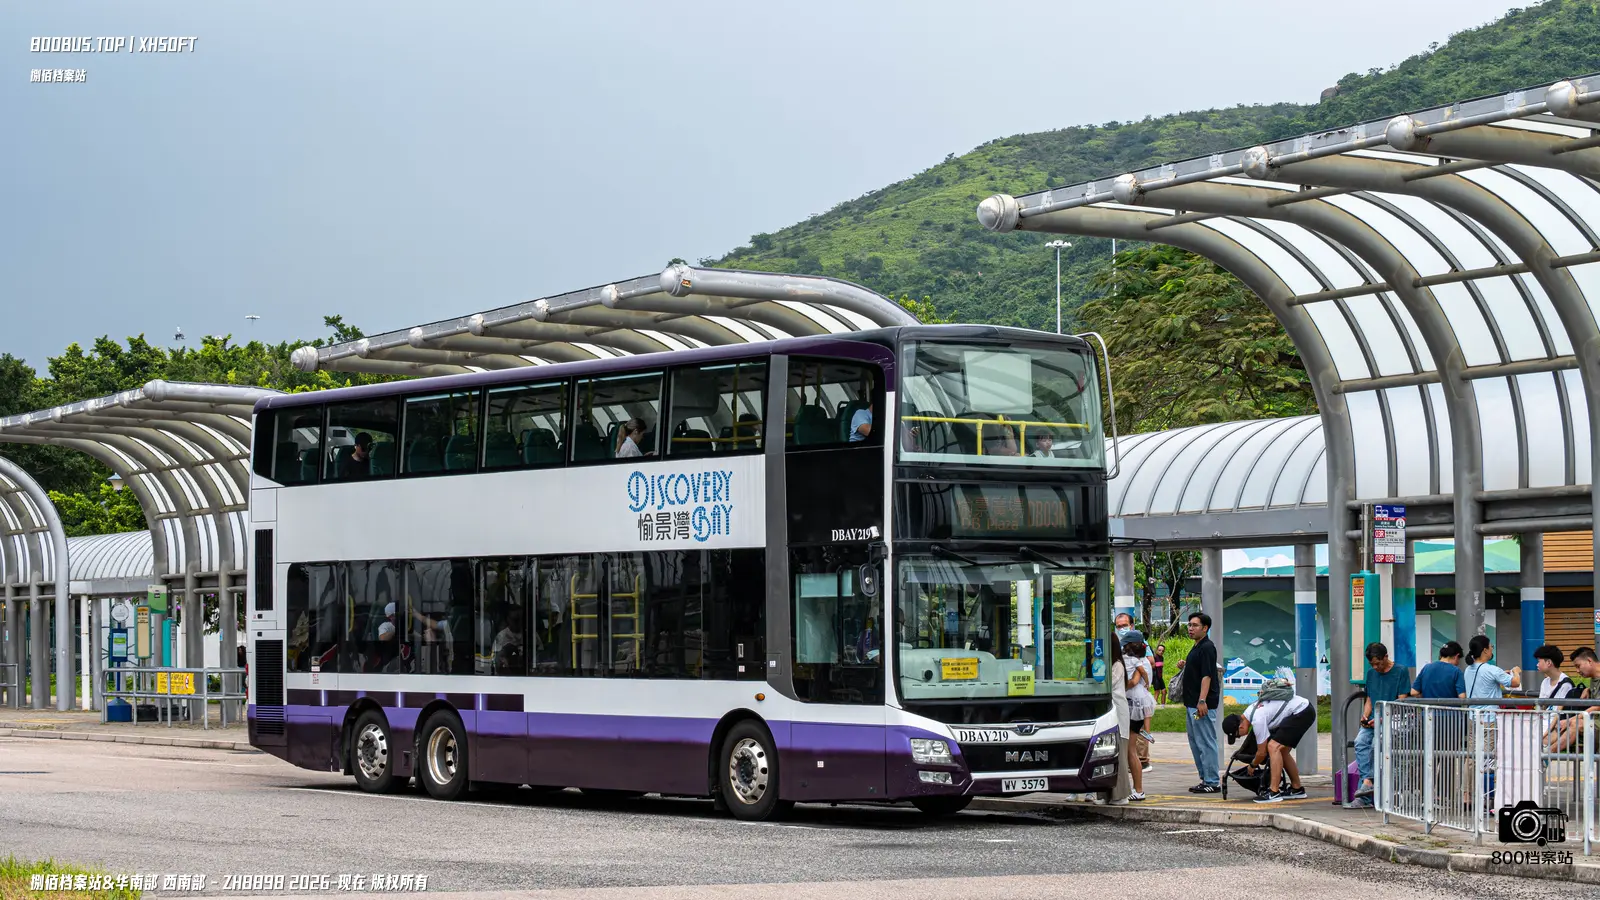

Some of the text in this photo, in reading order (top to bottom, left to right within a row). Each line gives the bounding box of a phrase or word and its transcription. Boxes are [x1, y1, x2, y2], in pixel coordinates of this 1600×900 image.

[627, 470, 733, 513] DISCOVERY
[638, 511, 690, 541] 愉景灣
[691, 504, 733, 542] BAY
[831, 527, 871, 541] DBAY219
[959, 730, 1009, 743] DBAY219
[1005, 750, 1049, 763] MAN
[1004, 778, 1046, 791] WV 3579
